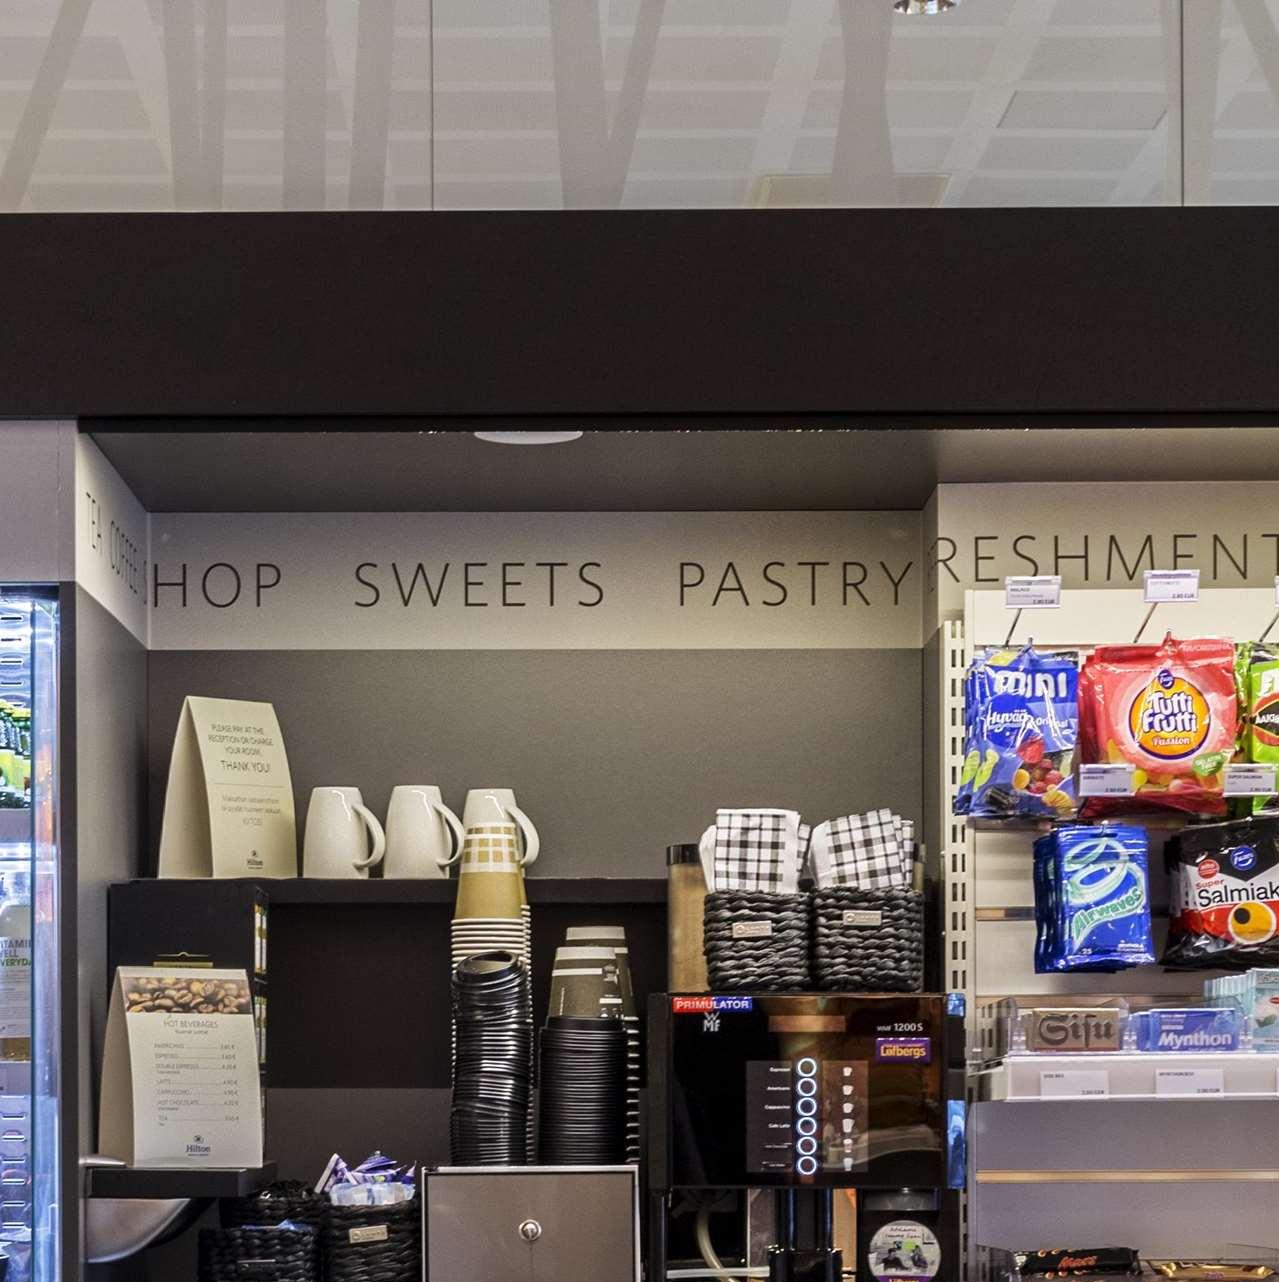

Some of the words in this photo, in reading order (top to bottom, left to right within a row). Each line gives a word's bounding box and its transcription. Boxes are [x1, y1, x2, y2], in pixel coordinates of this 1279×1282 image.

[354, 562, 603, 608] SWEETS
[680, 561, 914, 606] PASTRY
[992, 669, 1068, 699] mini
[1149, 692, 1194, 714] Tutti
[1142, 713, 1198, 733] Frutti
[1152, 737, 1190, 748] Passion
[1195, 878, 1225, 889] Super
[1073, 886, 1144, 942] Airwaves
[675, 999, 750, 1010] PRIMULATOR
[1158, 1031, 1233, 1048] Mynthon
[880, 1044, 927, 1058] Löfbergs
[185, 1144, 211, 1153] Hilton
